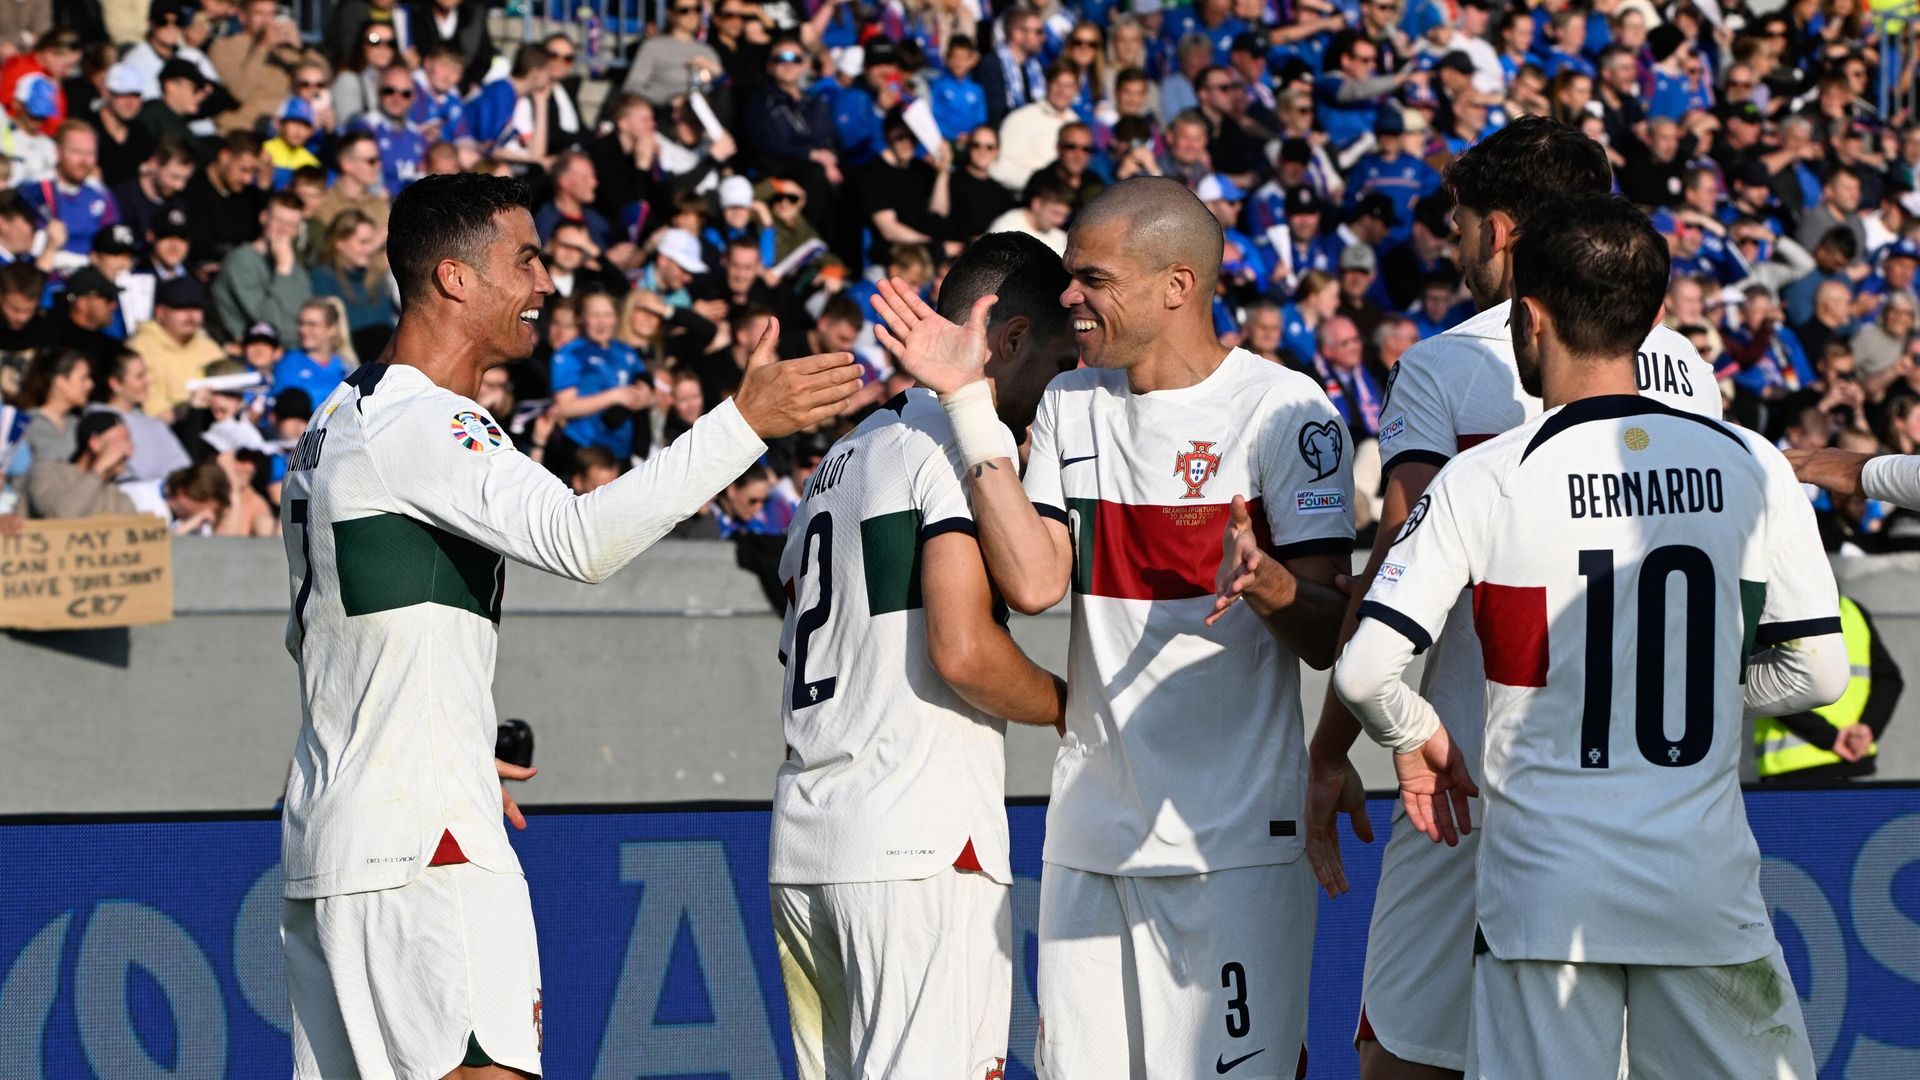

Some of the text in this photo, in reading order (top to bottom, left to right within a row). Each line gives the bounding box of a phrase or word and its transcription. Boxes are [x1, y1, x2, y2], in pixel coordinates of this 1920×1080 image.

[1636, 351, 1694, 397] DIAS
[287, 427, 328, 471] ONALDO
[805, 447, 855, 503] ALOT
[1297, 491, 1314, 499] UEFA
[1567, 467, 1724, 519] BERNARDO
[1297, 496, 1346, 508] FOUNDA
[65, 530, 110, 550] MY
[0, 558, 49, 576] CAN
[3, 576, 60, 599] HAVE
[66, 594, 127, 618] CR7
[792, 511, 837, 711] 2
[1578, 544, 1716, 768] 10
[1221, 961, 1250, 1038] 3
